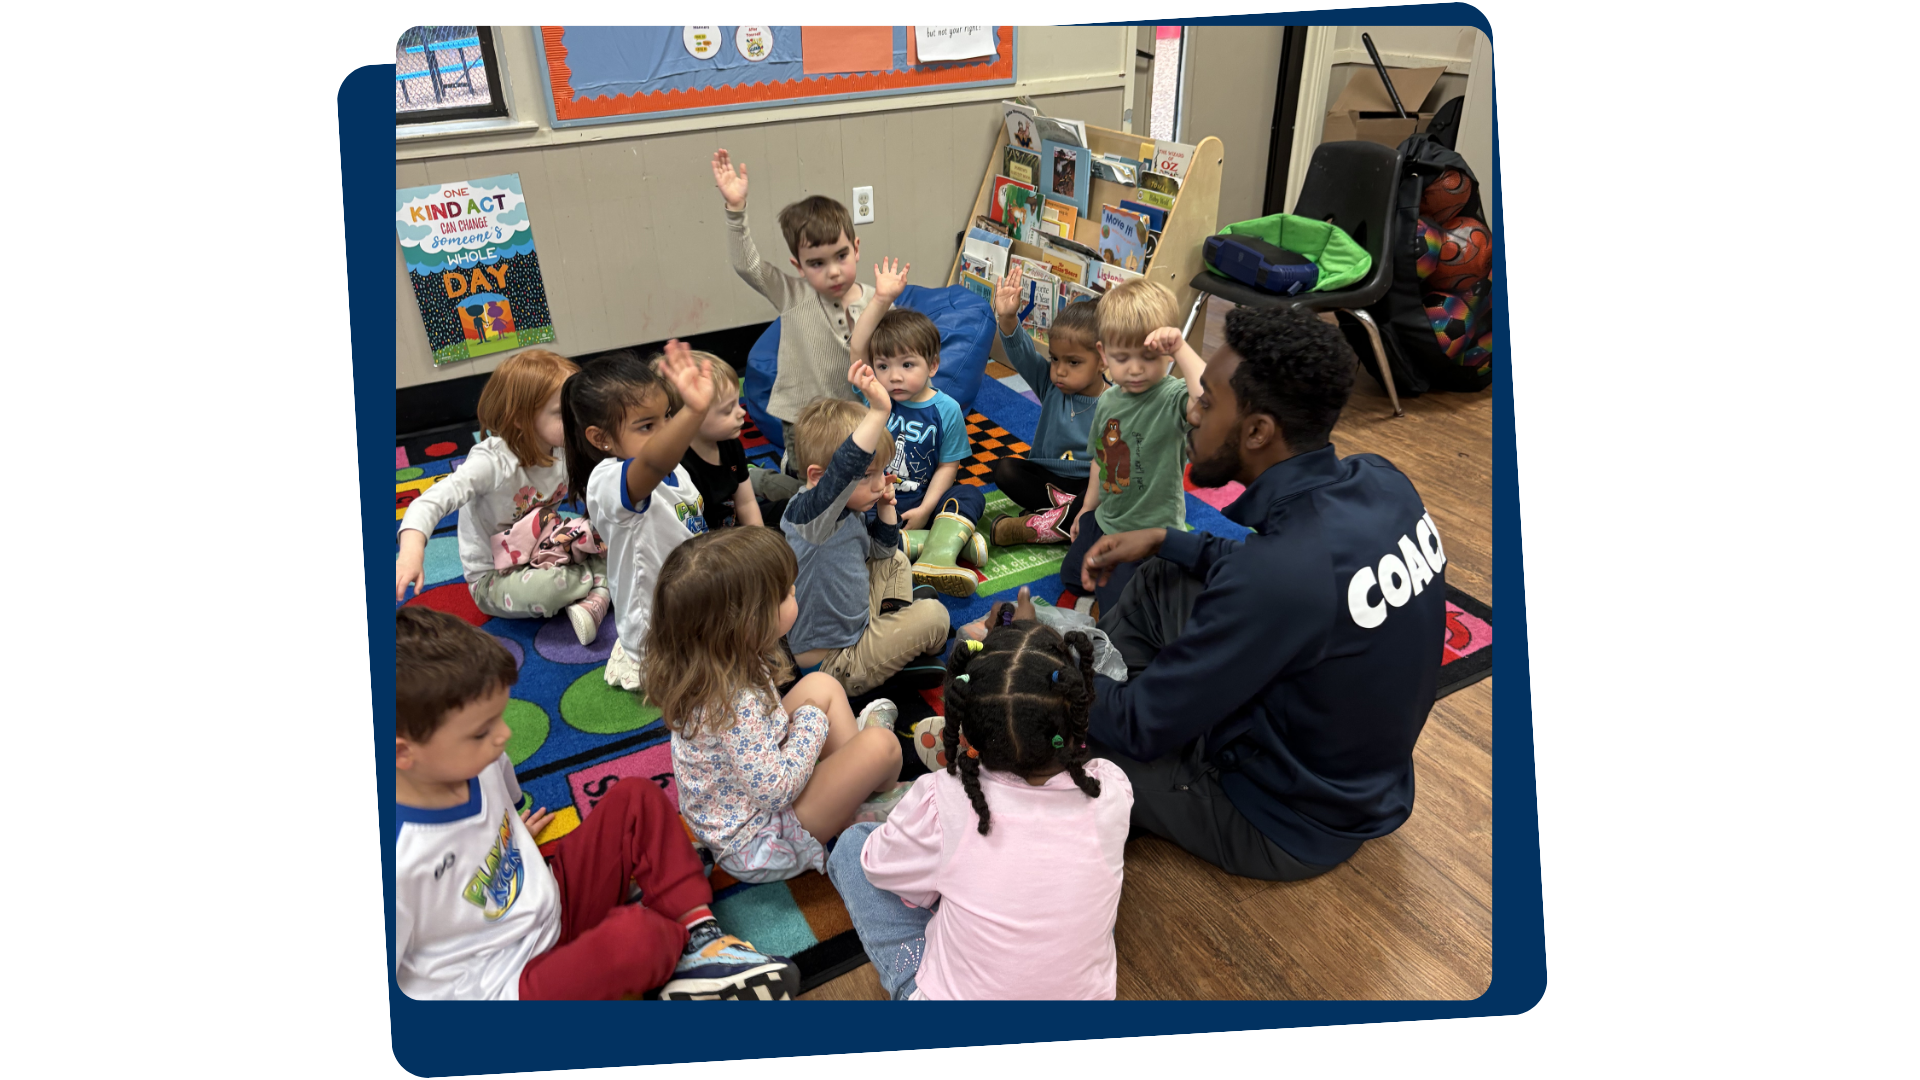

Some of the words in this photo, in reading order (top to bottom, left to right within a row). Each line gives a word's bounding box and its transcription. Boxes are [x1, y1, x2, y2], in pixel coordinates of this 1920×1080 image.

[926, 27, 936, 38] but
[938, 28, 947, 36] not
[949, 27, 962, 39] your
[1161, 160, 1179, 172] OZ
[443, 188, 470, 199] ONE
[409, 201, 462, 223] KIND
[467, 194, 506, 215] ACT
[440, 222, 457, 235] CAN
[458, 216, 488, 232] CHANGE
[1105, 213, 1125, 230] Move
[432, 226, 503, 249] someone's
[446, 247, 497, 266] WHOLE
[443, 264, 509, 299] DAY
[1347, 507, 1447, 629] COAC
